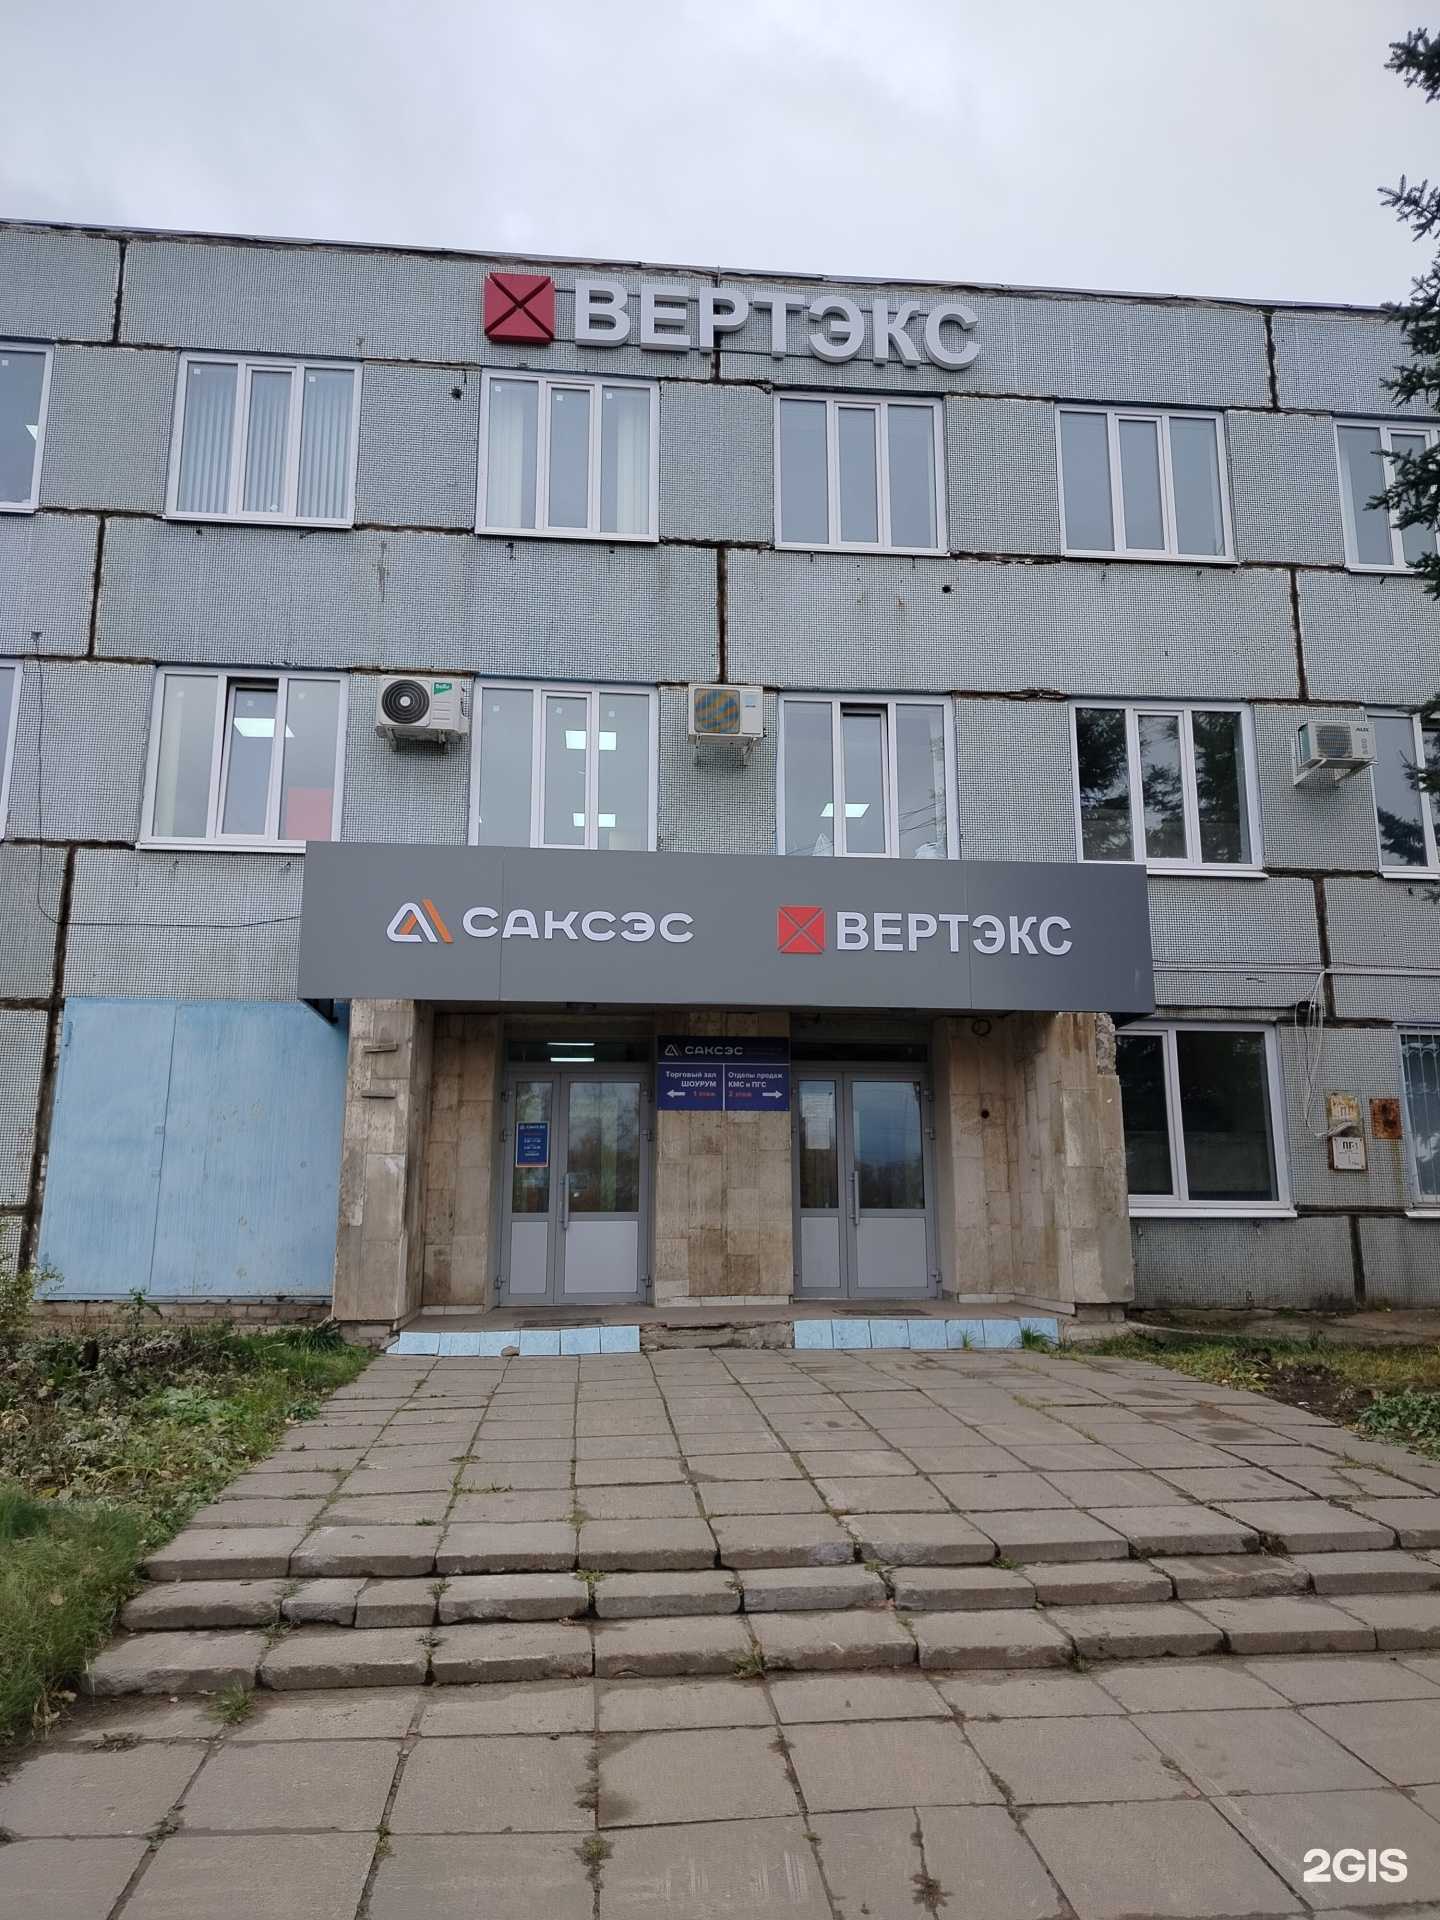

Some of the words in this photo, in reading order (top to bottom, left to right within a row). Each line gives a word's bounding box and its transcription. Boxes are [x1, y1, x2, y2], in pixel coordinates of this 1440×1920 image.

[574, 278, 981, 371] ВЕРТЭКС
[462, 906, 695, 944] САКСЭС
[835, 910, 1073, 956] ВЕРТЭКС
[684, 1045, 744, 1056] САКСЭС
[665, 1070, 703, 1079] Торговый
[728, 1071, 756, 1079] Отделы
[681, 1080, 717, 1088] ШОУРУМ
